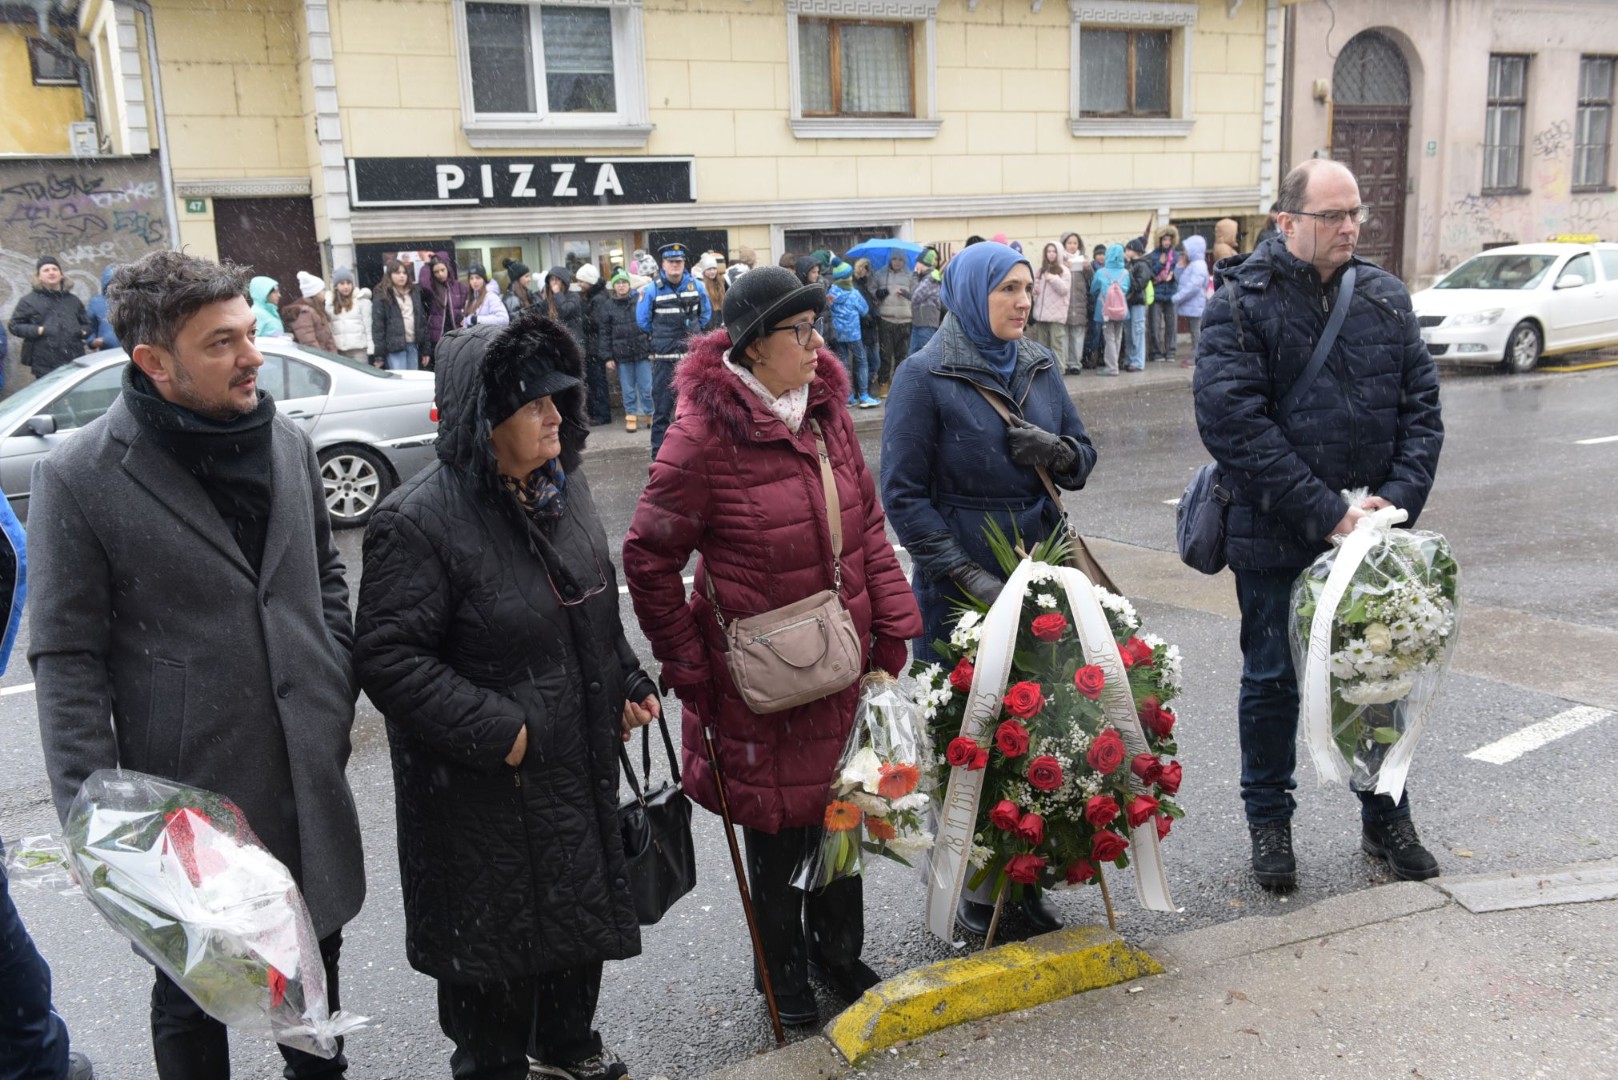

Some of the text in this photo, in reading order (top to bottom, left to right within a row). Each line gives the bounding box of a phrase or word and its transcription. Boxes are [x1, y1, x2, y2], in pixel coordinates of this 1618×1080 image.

[436, 163, 624, 199] PIZZA
[189, 201, 203, 211] 47
[1089, 641, 1112, 653] S
[970, 693, 998, 731] 2025
[949, 782, 976, 812] 1993
[945, 817, 969, 831] 11
[944, 834, 965, 856] 28
